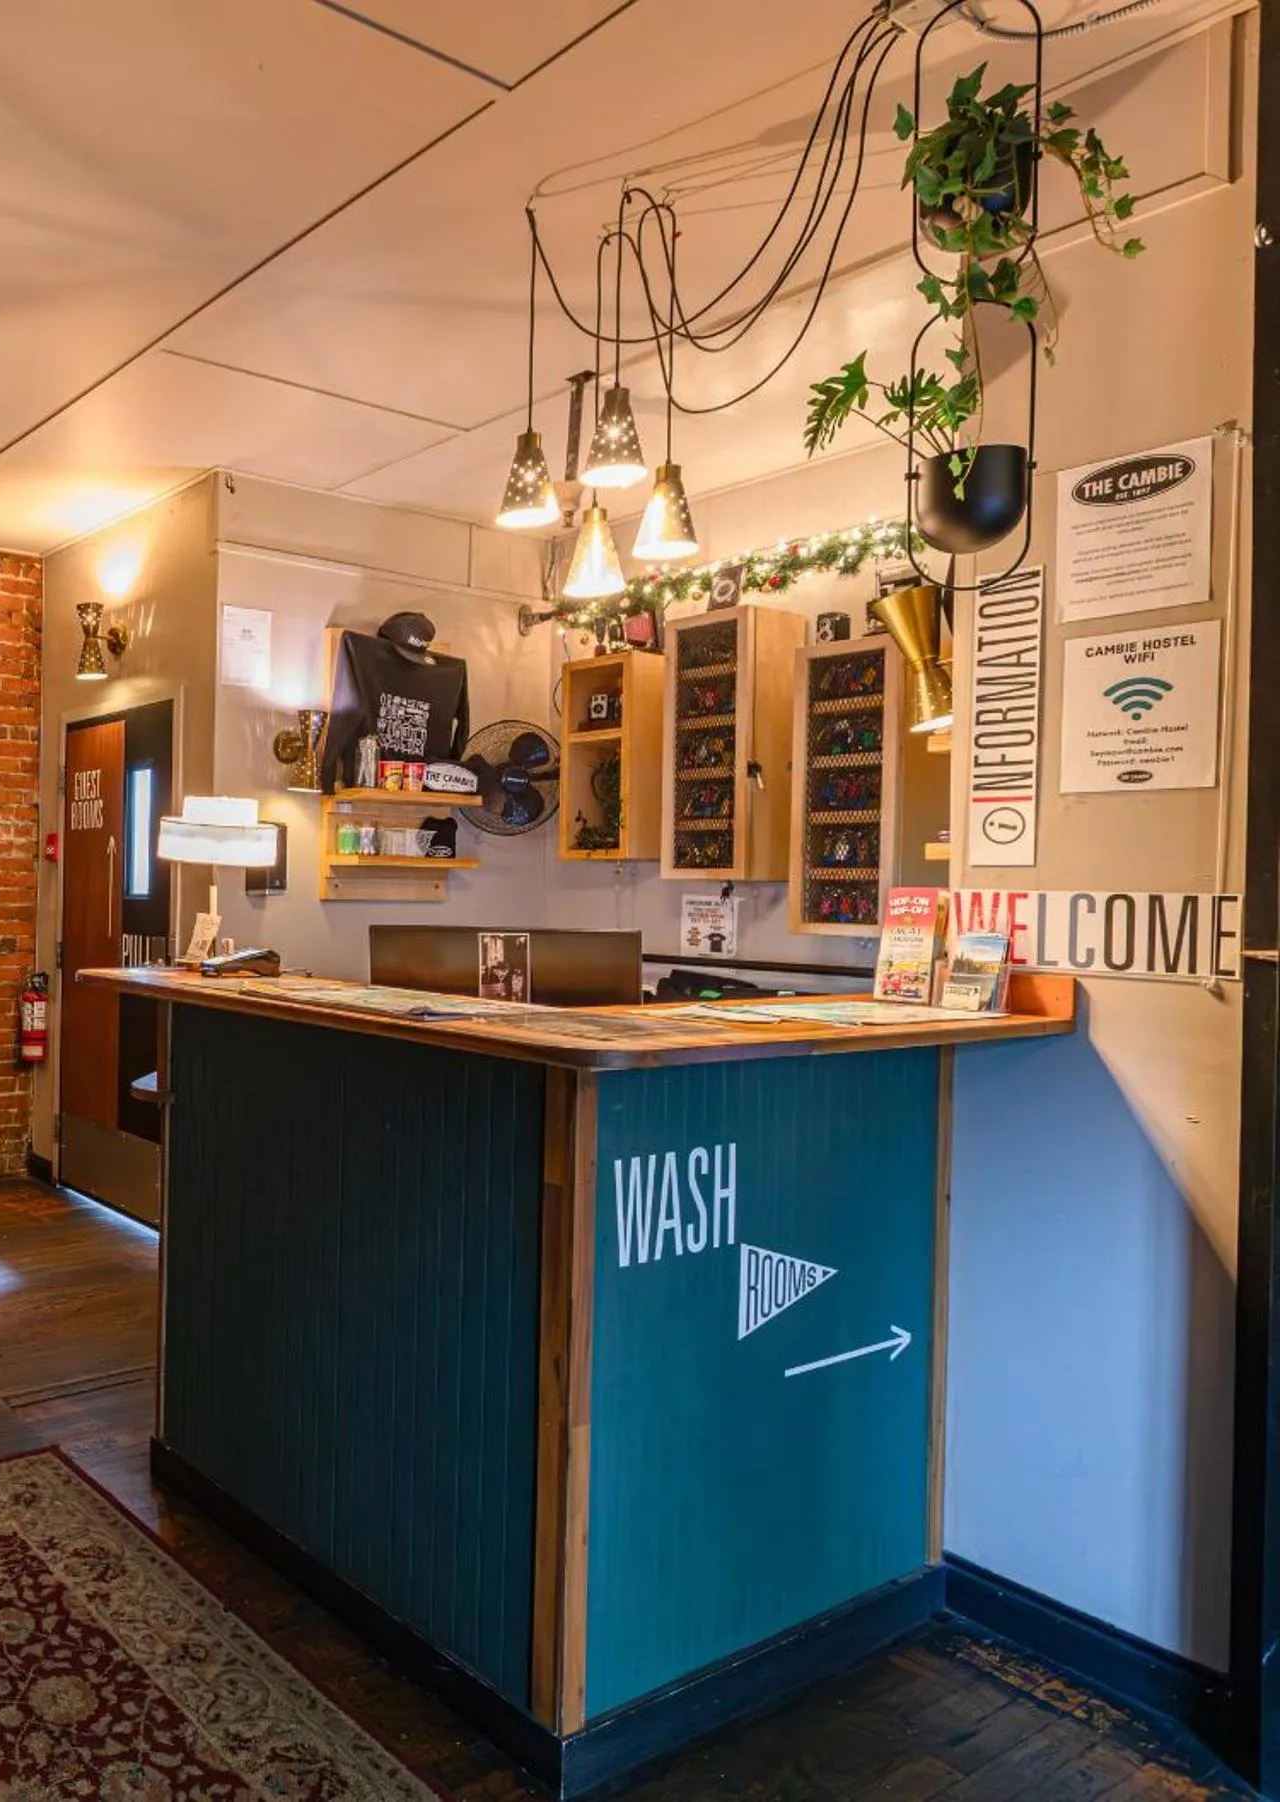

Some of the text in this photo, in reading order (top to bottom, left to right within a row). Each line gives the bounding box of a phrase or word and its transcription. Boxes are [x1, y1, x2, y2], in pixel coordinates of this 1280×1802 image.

[1082, 461, 1184, 498] THE CAMBIE
[1085, 634, 1197, 658] CAMBIE HOSTEL
[1123, 651, 1155, 664] WIFI
[972, 568, 1041, 803] INFORMATION
[74, 769, 101, 801] GUEST
[71, 799, 104, 831] ROOMS
[953, 891, 1239, 977] WELCOME
[614, 1142, 737, 1267] WASH
[745, 1249, 817, 1332] ROOMS
